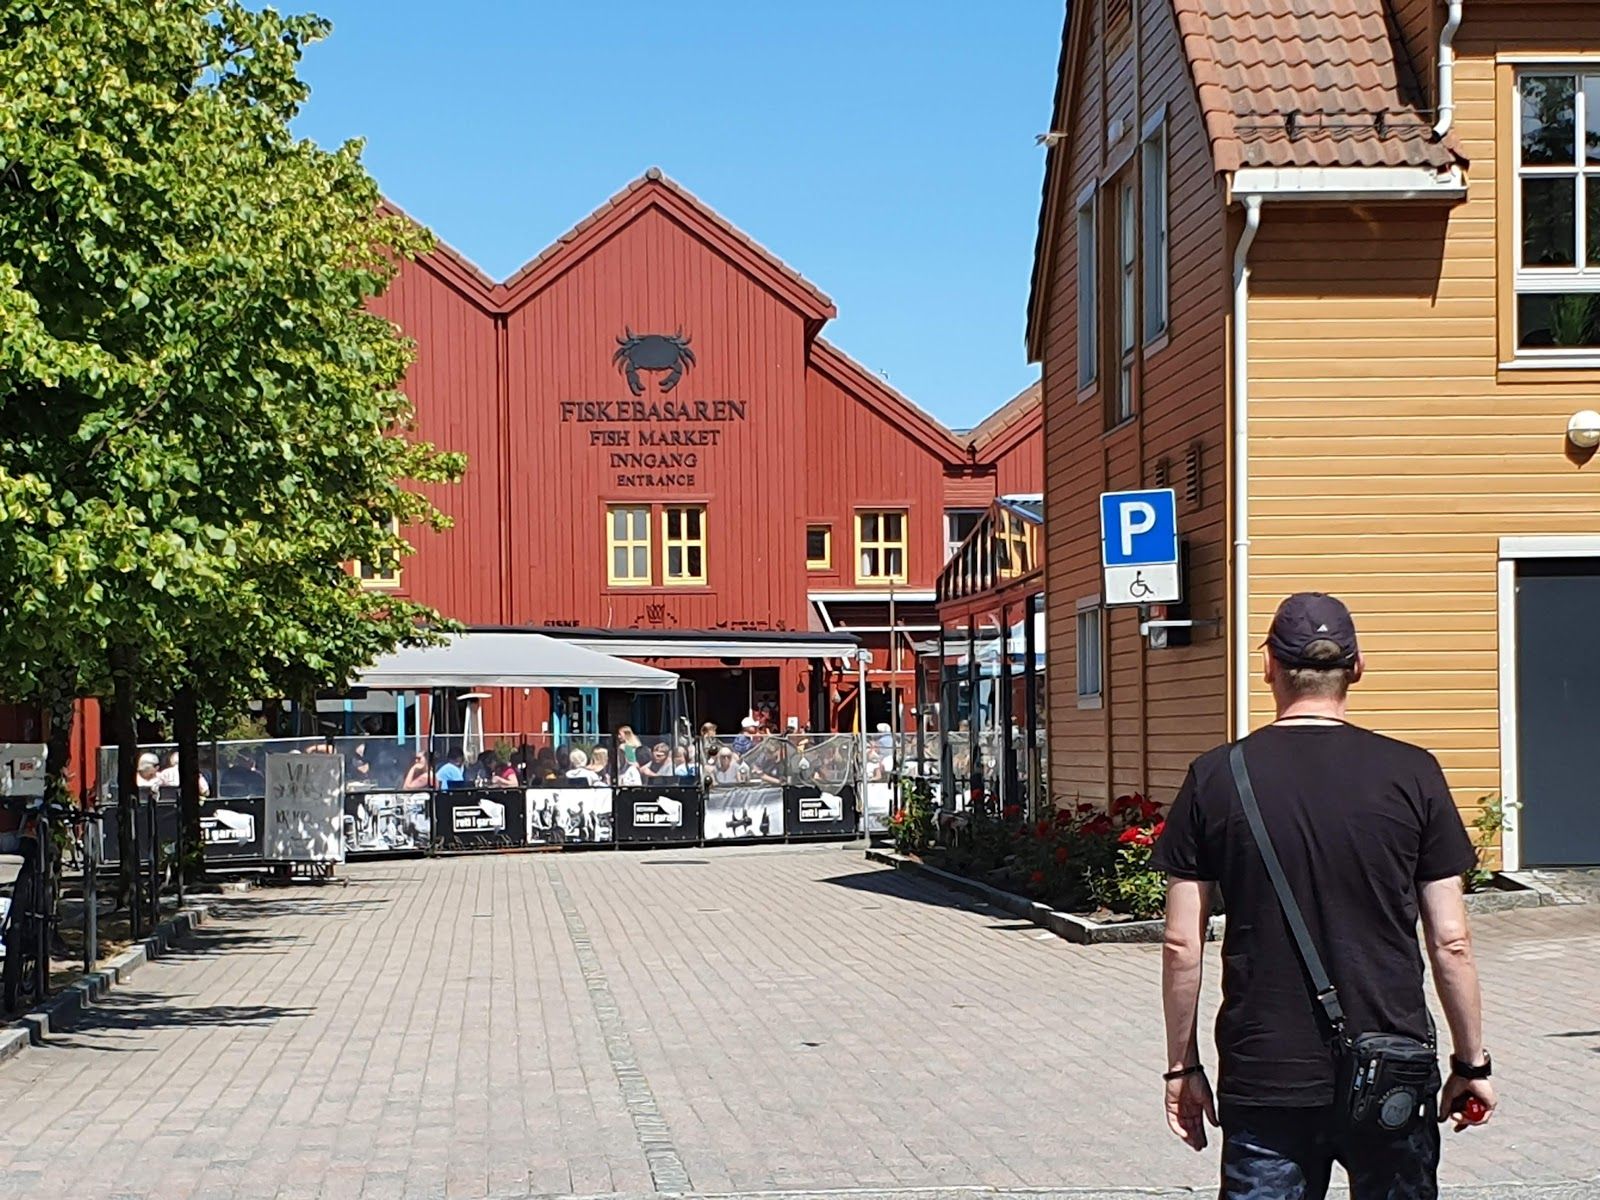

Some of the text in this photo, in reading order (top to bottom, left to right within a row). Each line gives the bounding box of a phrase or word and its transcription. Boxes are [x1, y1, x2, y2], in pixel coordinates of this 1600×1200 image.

[560, 401, 746, 422] FISKEBASAREN
[590, 430, 721, 447] FISH MARKET
[610, 453, 697, 469] INNGANG
[617, 474, 695, 487] ENTRANCE
[1119, 501, 1157, 557] P
